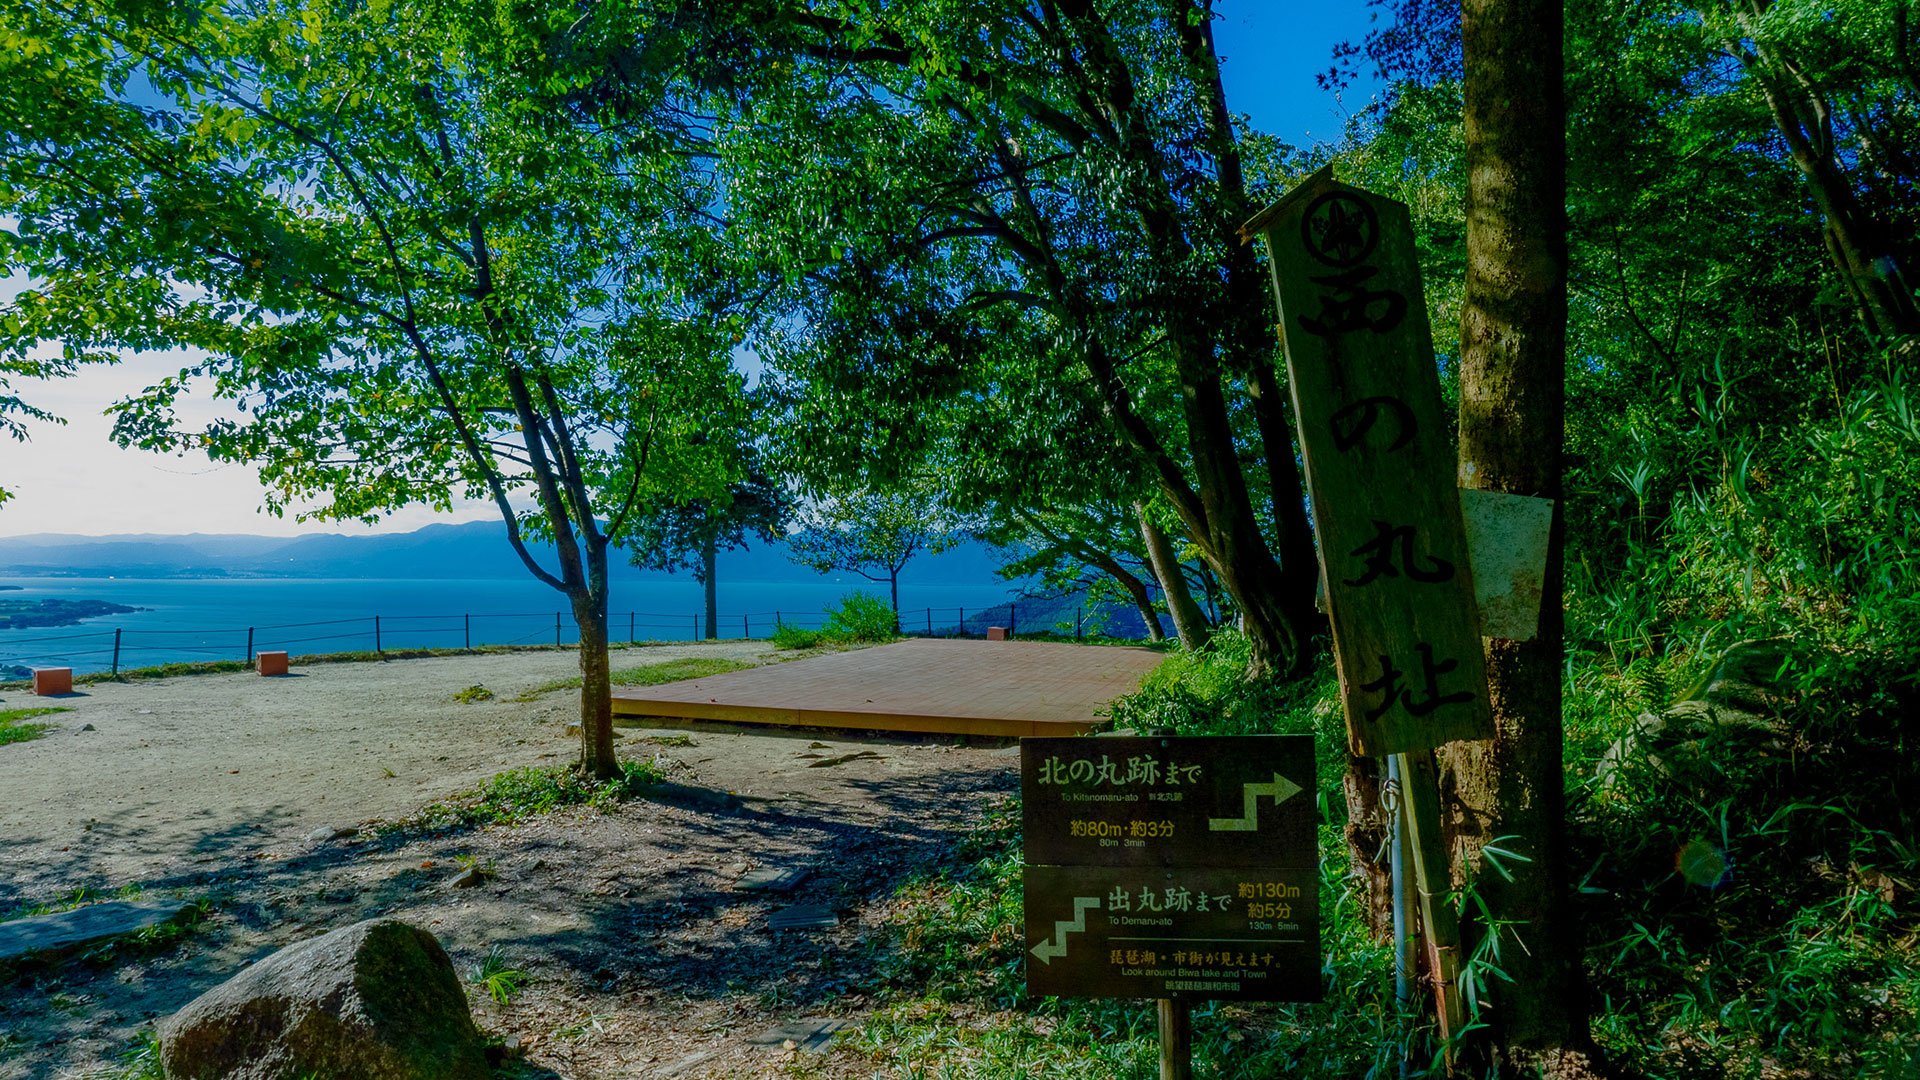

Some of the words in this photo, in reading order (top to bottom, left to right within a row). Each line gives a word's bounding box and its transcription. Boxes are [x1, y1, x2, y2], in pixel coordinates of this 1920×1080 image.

[1298, 266, 1476, 723] 西の丸址
[1038, 754, 1202, 786] 北の丸跡まで
[1061, 793, 1071, 802] To
[1073, 793, 1139, 802] Kitanomaru-ato
[1099, 838, 1119, 847] 80m
[1124, 838, 1146, 847] 3min
[1108, 885, 1233, 912] 出丸跡まで
[1238, 882, 1301, 899] 約130m
[1248, 902, 1293, 919] 約5分
[1108, 916, 1119, 925] To
[1121, 916, 1173, 926] Demaru-ato
[1249, 922, 1273, 931] 130m
[1278, 922, 1299, 931] 5min
[1110, 949, 1281, 968] 琵琶湖・市街が見えます。
[1122, 967, 1143, 976] Look
[1145, 968, 1176, 977] around
[1178, 968, 1200, 977] Biwa
[1202, 968, 1221, 978] lake
[1222, 968, 1240, 978] and
[1243, 969, 1267, 979] Town
